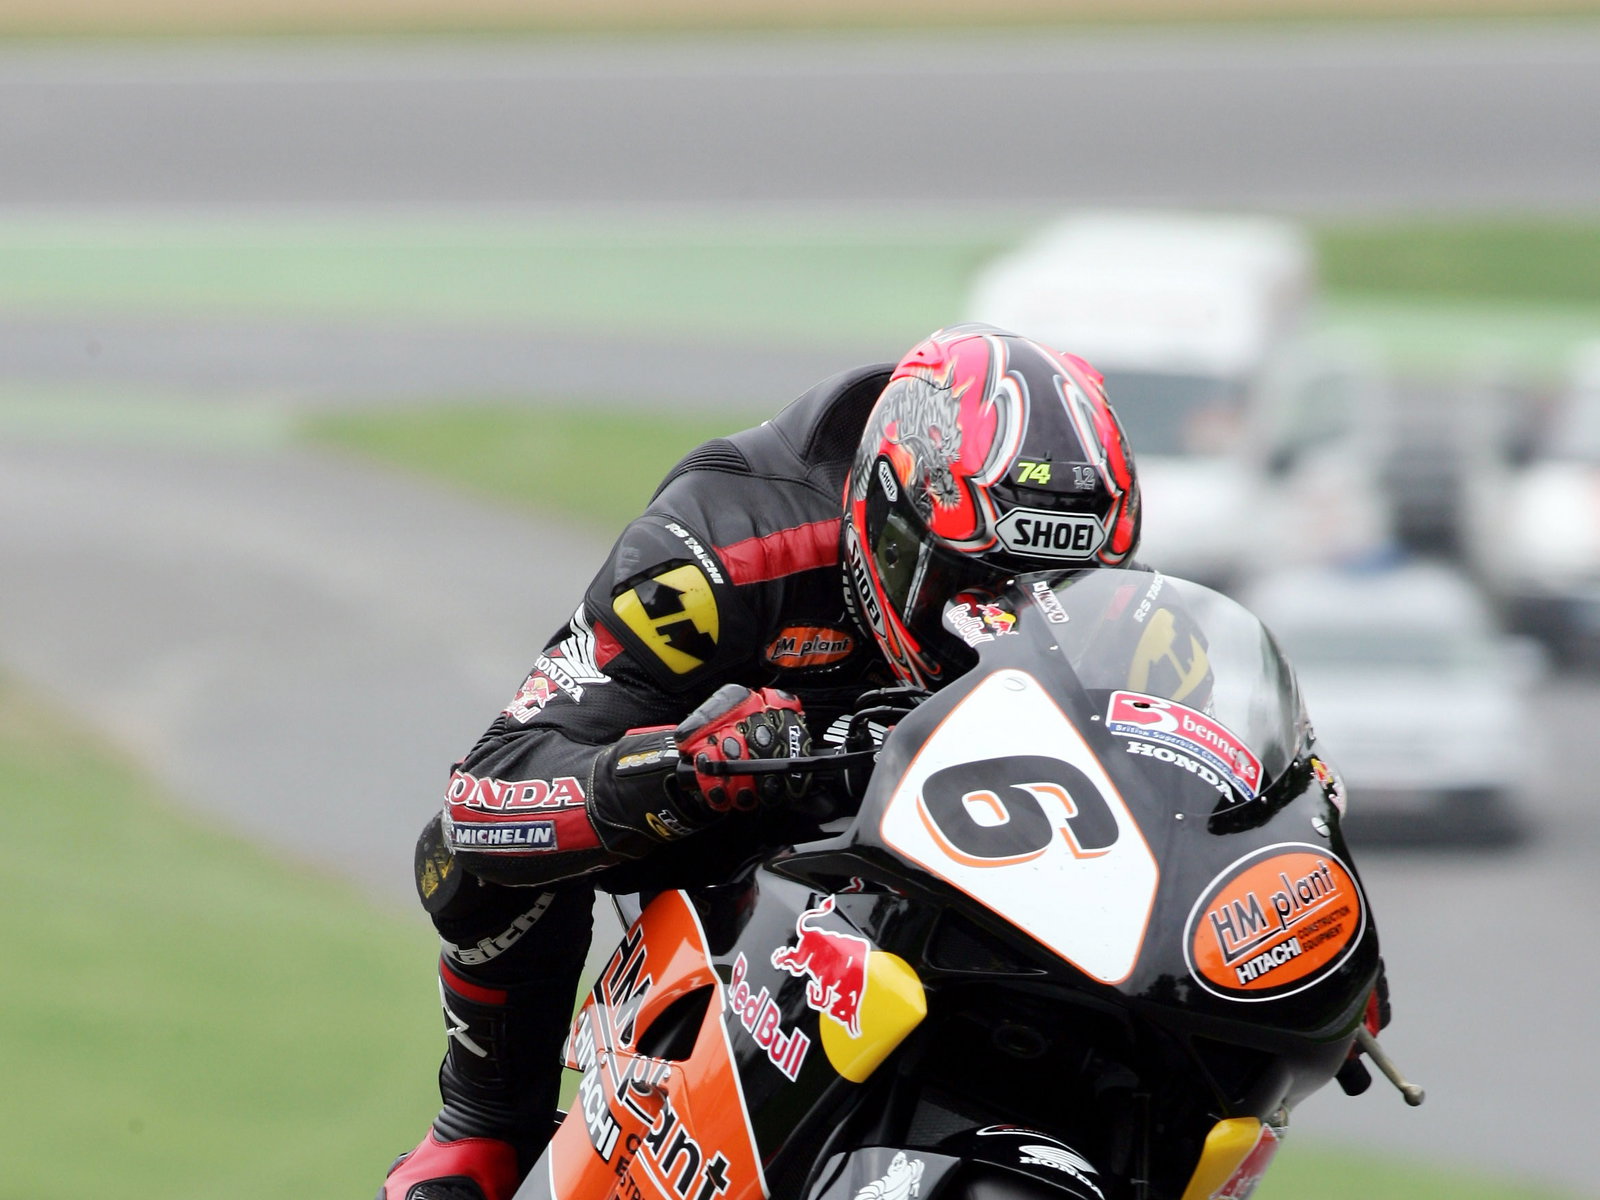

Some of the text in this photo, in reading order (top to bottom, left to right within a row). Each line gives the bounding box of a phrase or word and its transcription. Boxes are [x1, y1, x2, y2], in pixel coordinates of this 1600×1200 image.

[879, 466, 896, 497] SHOEI
[1017, 461, 1051, 485] 74
[1072, 465, 1095, 484] 12
[664, 522, 690, 538] RS
[1012, 518, 1094, 551] SHOEI
[799, 634, 851, 658] plant
[444, 769, 587, 810] ONDA
[1126, 741, 1236, 803] HONDA
[917, 755, 1120, 867] 6
[456, 828, 551, 844] MICHELIN
[1208, 860, 1337, 967] HM plant
[1235, 936, 1303, 986] HITACHI
[594, 922, 654, 1050] HM
[575, 1010, 622, 1162] HITACHI
[1019, 1156, 1106, 1200] HONDA
